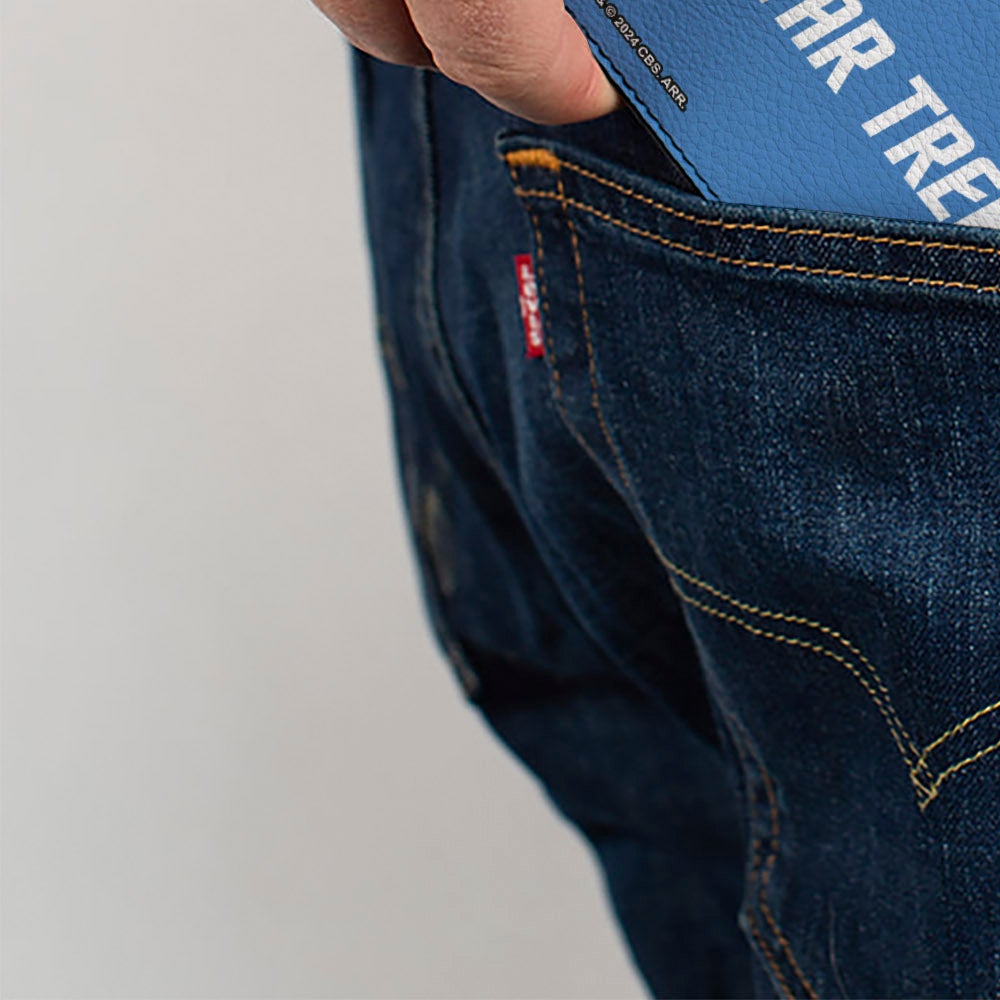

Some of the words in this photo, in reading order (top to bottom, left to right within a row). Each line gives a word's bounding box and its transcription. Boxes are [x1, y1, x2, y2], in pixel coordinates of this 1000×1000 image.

[613, 16, 641, 48] 2024
[637, 46, 663, 79] CBS.
[660, 76, 687, 110] ARR.
